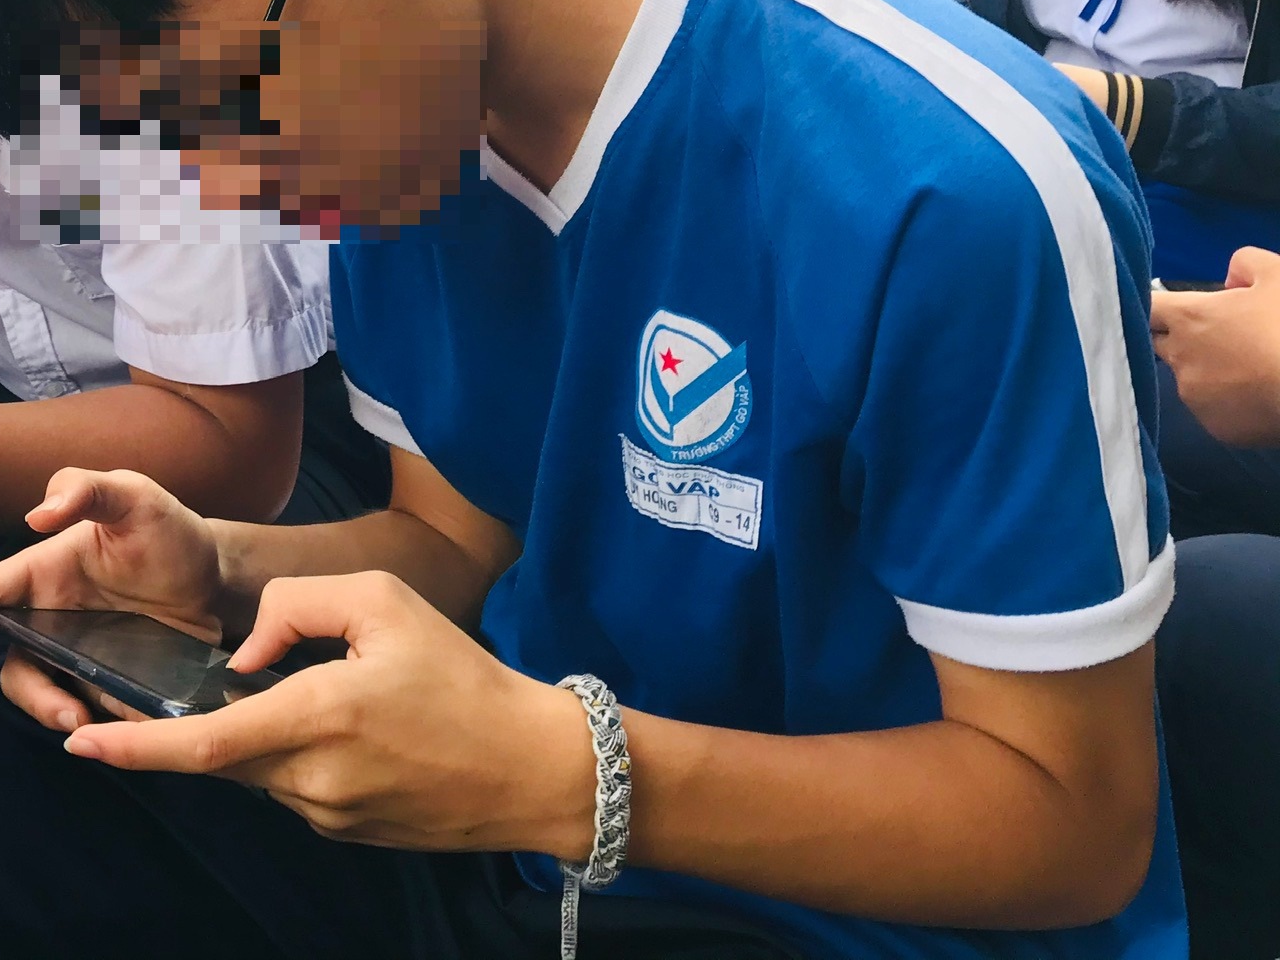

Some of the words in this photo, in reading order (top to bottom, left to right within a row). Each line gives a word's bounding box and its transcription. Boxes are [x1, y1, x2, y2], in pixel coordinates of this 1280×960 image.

[715, 422, 740, 447] THPT
[733, 407, 748, 424] GÒ
[736, 512, 751, 532] 14
